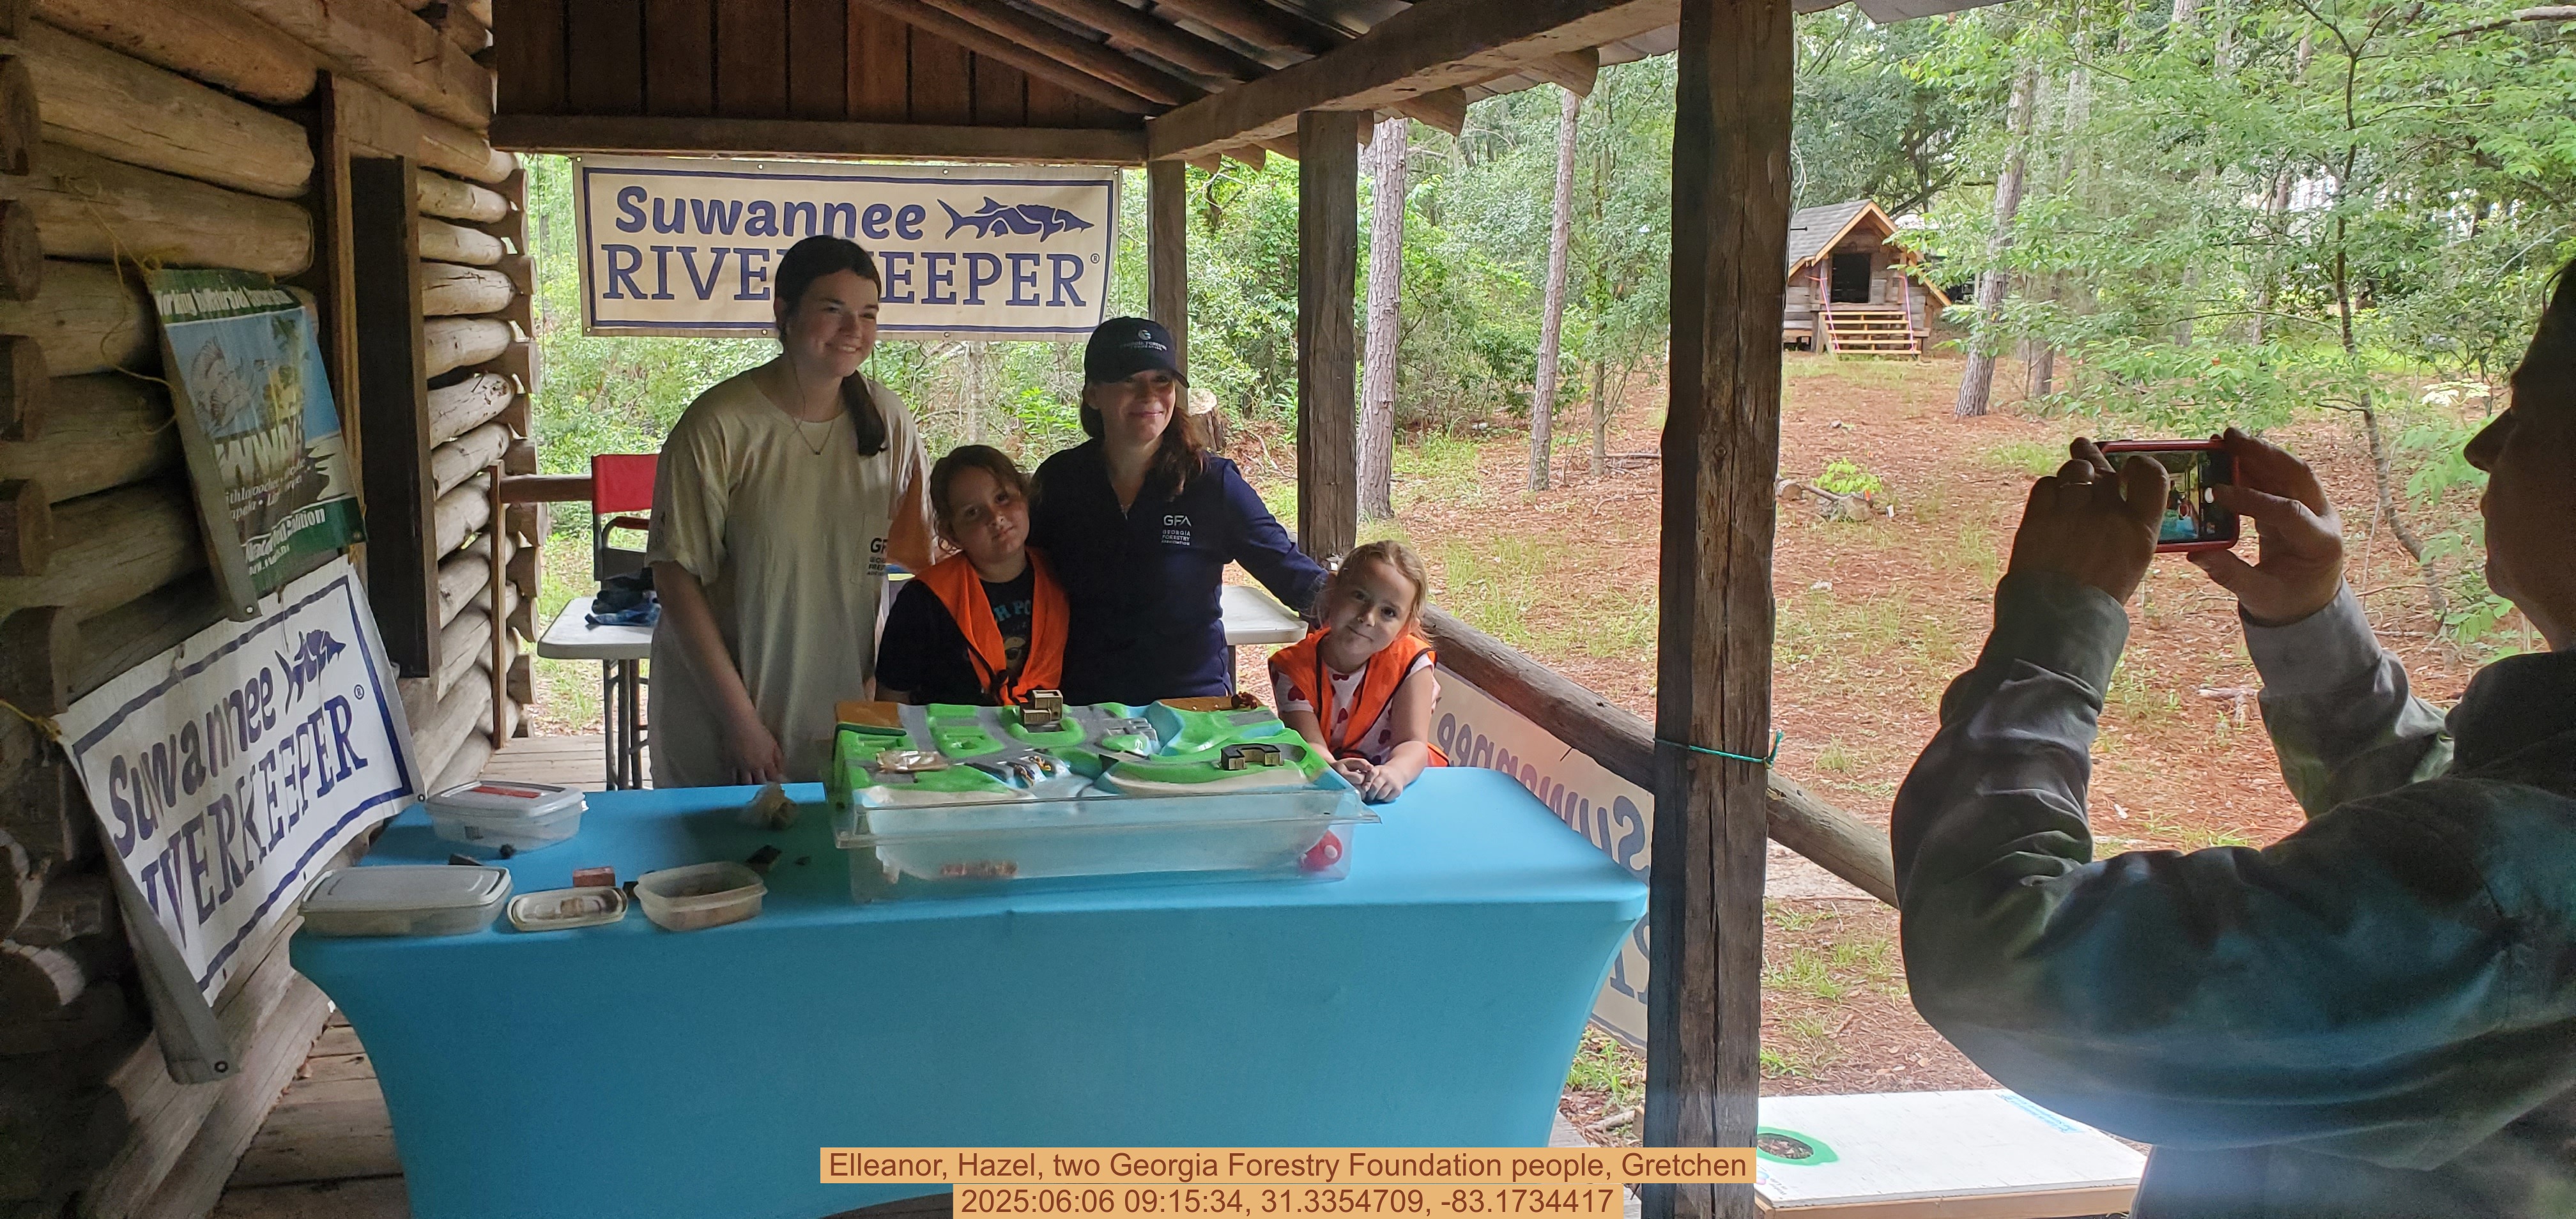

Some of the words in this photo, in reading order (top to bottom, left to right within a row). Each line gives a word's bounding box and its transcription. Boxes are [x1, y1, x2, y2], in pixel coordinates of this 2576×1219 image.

[615, 186, 926, 241] Suwannee
[601, 244, 1087, 307] RIVEEEPER
[870, 537, 888, 554] GF
[1163, 515, 1192, 526] GFA
[108, 667, 277, 859] Suwannee
[141, 694, 369, 951] IVERKEEPER
